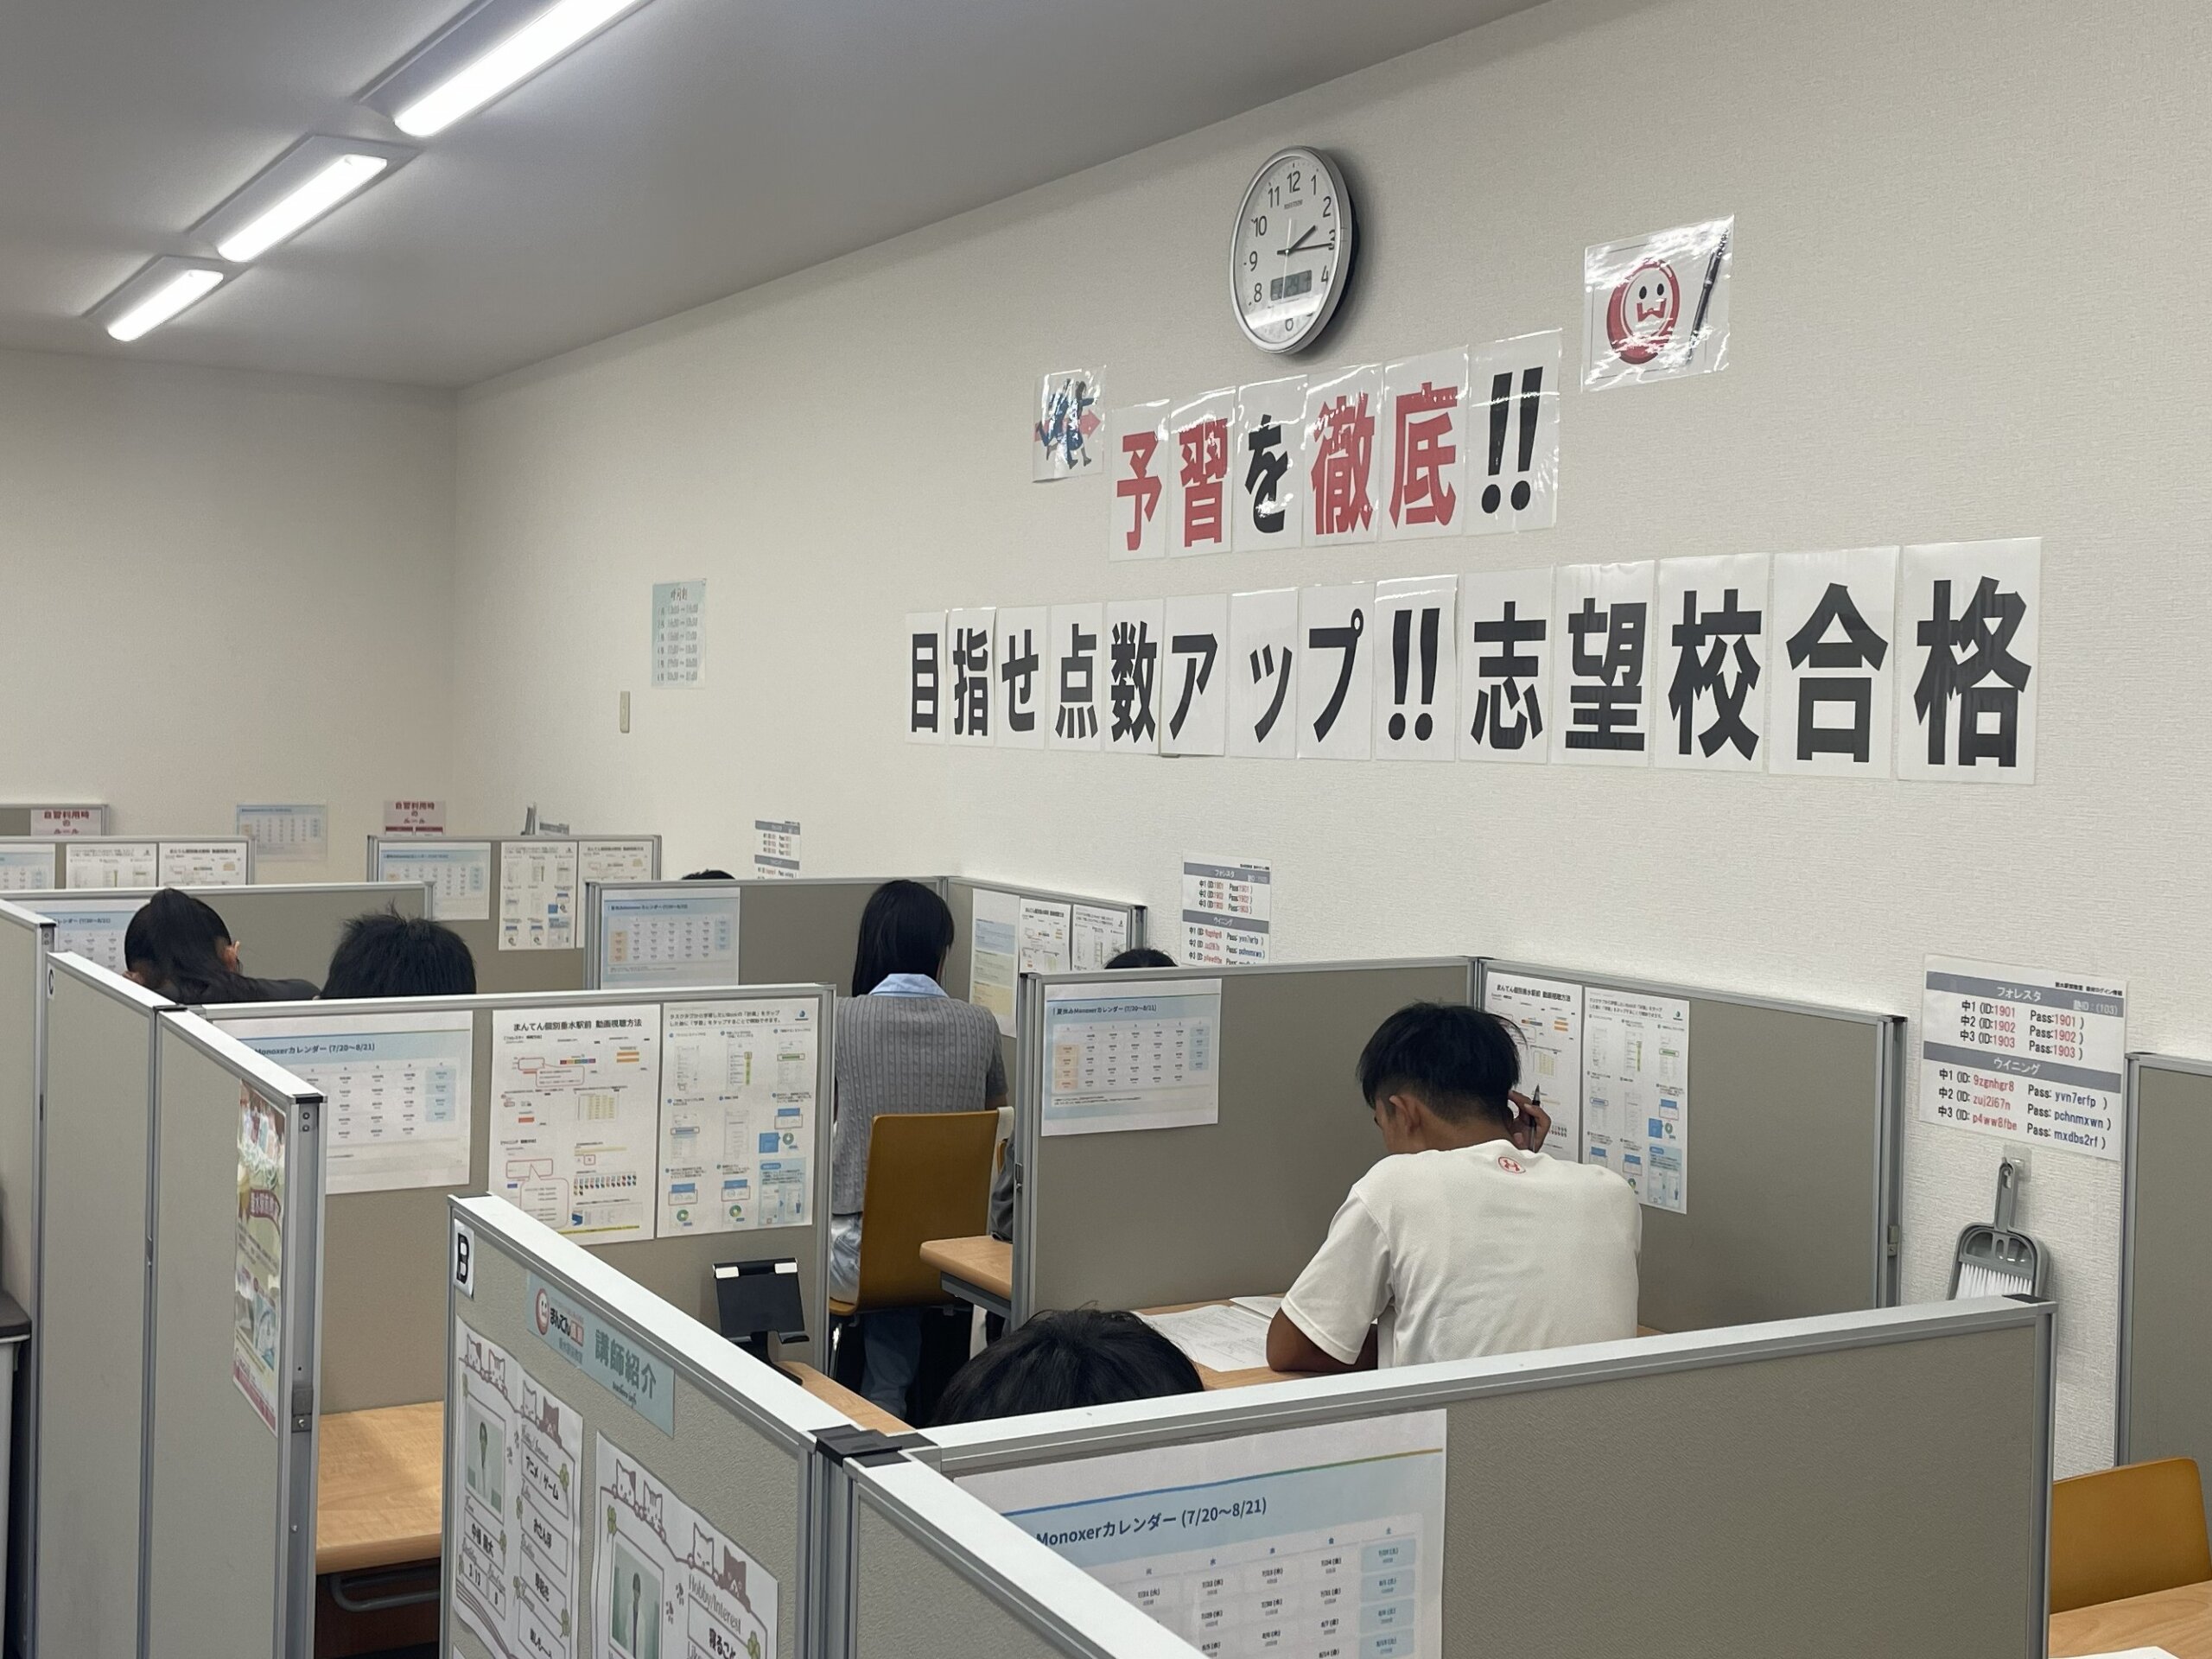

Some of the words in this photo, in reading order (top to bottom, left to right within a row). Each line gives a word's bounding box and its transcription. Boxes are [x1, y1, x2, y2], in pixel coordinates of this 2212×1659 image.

[1287, 170, 1301, 194] 12
[1311, 175, 1317, 196] 1
[1268, 186, 1280, 208] 11
[1322, 196, 1332, 218] 2
[1251, 215, 1268, 238] 10
[1328, 229, 1336, 251] 3
[1249, 251, 1258, 271] 9
[1320, 265, 1329, 283] 4
[1254, 283, 1262, 302] 8
[1116, 366, 1544, 551] 予習を徹底!!
[48, 969, 54, 995] C
[1997, 986, 2042, 1002] フォレスタ
[1961, 1000, 1975, 1013] 中1
[1961, 1014, 1975, 1027] 中2
[1960, 1029, 1975, 1042] 中3
[1939, 1068, 1953, 1080] 中1
[1993, 1057, 2041, 1075] ウイニング
[1938, 1086, 1953, 1099] 中2
[1938, 1105, 1953, 1117] 中3
[455, 1231, 470, 1285] B
[594, 1328, 657, 1400] 講師紹介
